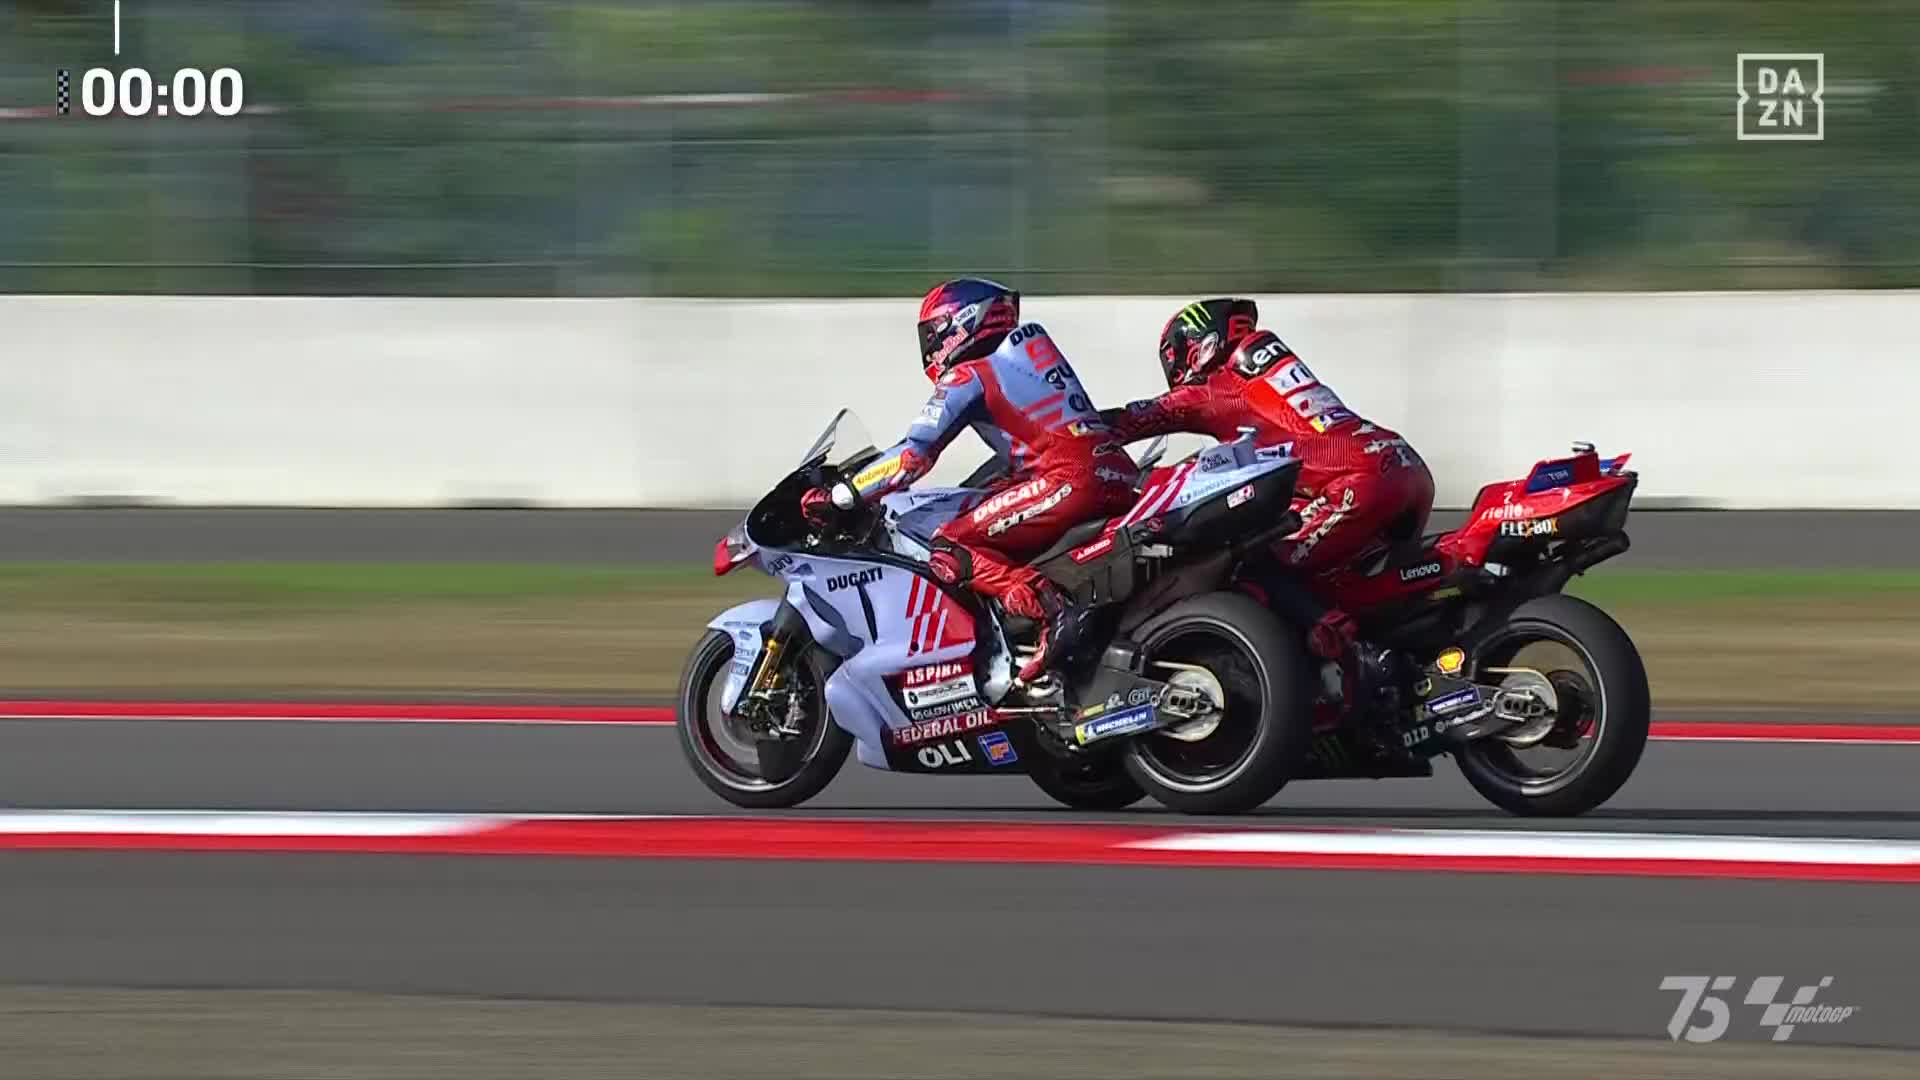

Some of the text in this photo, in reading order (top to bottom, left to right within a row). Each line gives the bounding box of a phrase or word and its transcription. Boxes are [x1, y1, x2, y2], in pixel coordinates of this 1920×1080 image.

[973, 477, 1047, 524] DUCATI
[827, 567, 883, 593] DUCATI
[1400, 563, 1441, 581] Lenovo
[893, 711, 993, 745] FEDERAL OIL
[917, 739, 973, 769] OLI
